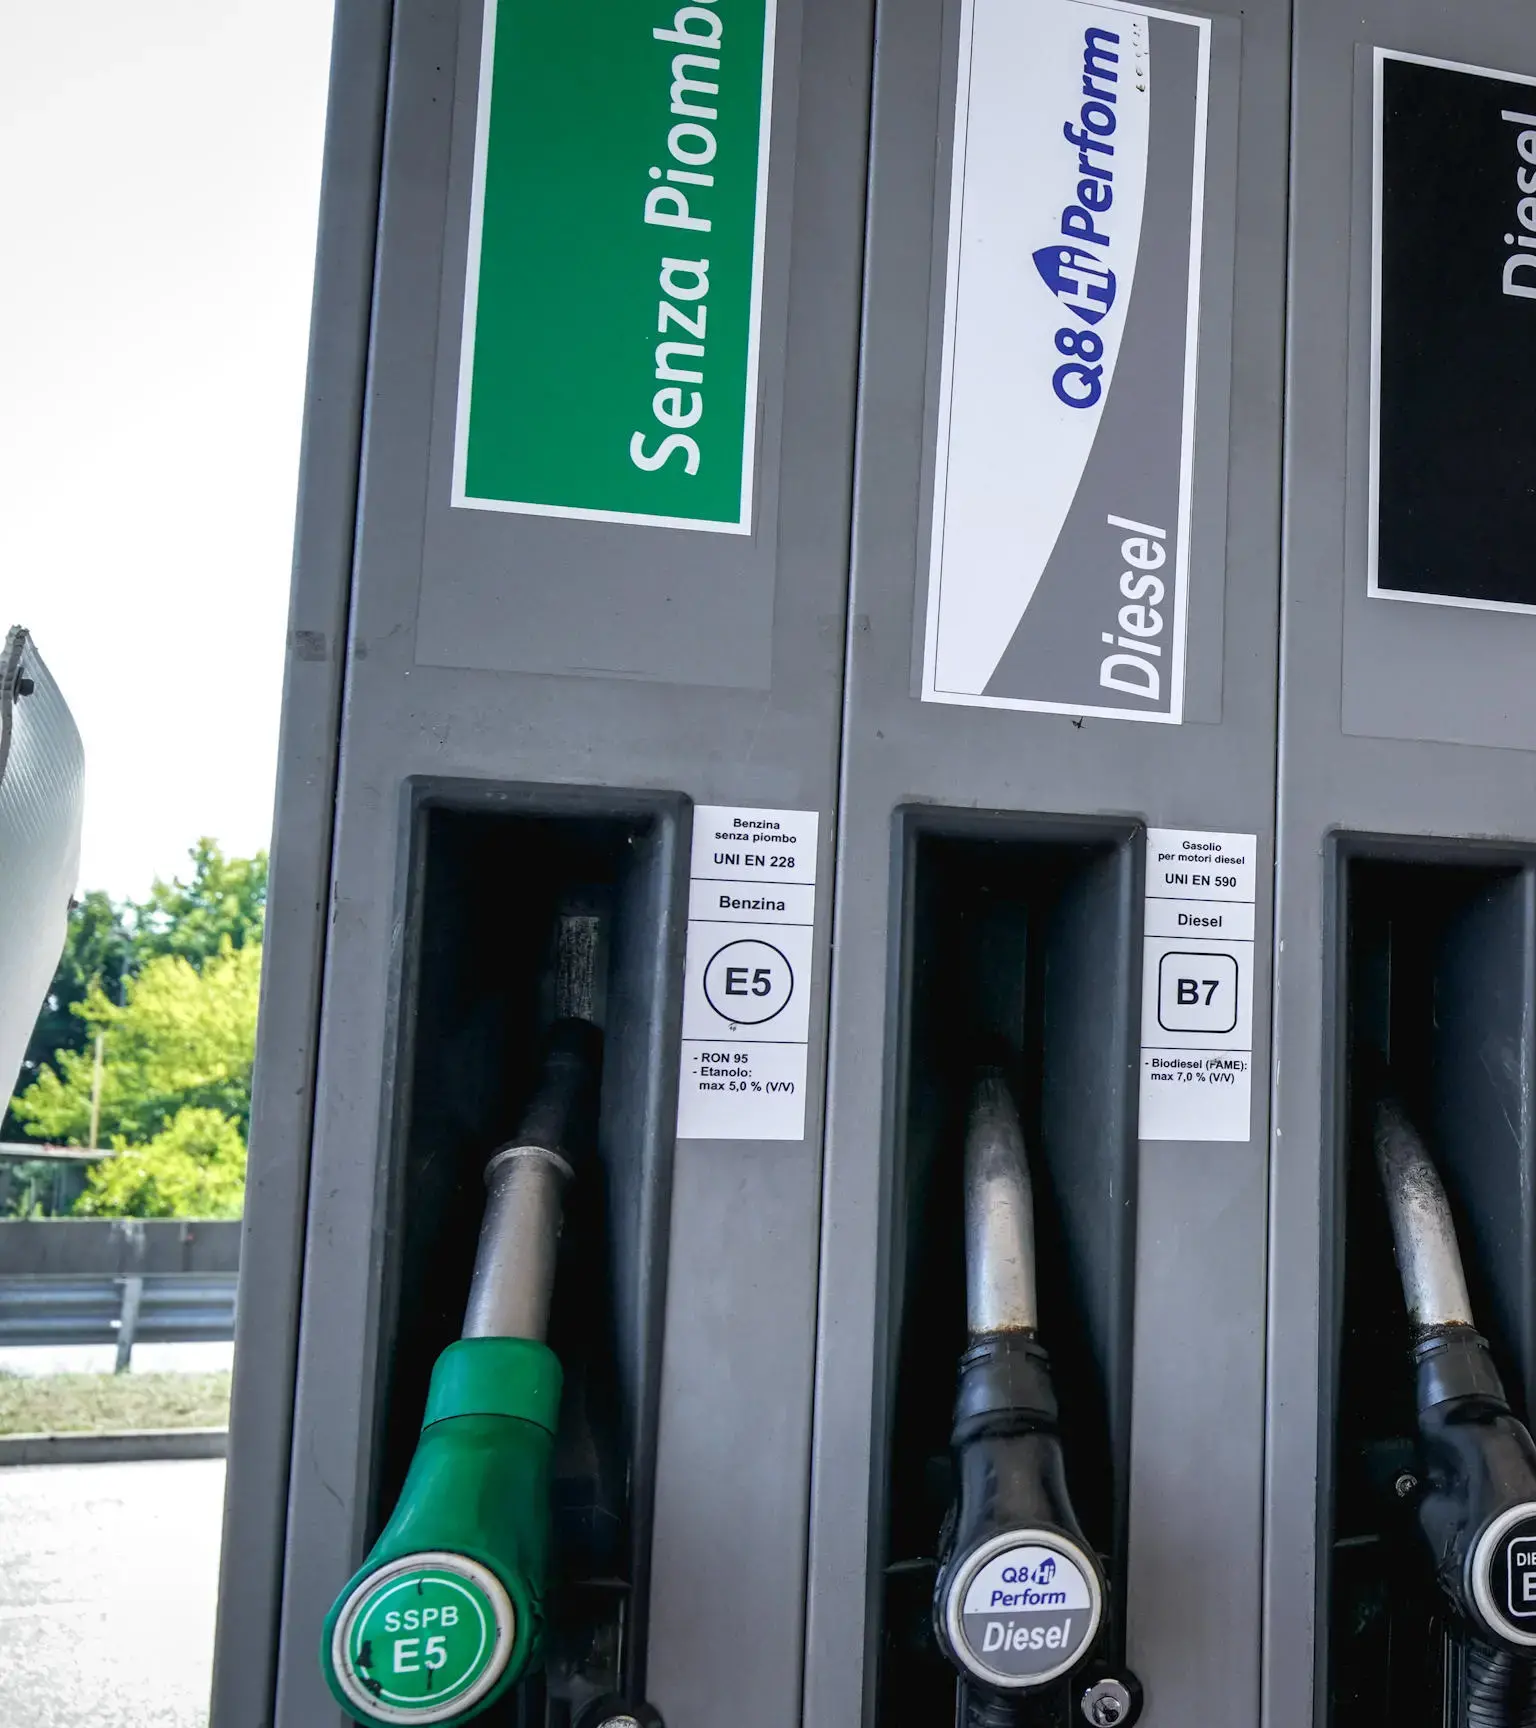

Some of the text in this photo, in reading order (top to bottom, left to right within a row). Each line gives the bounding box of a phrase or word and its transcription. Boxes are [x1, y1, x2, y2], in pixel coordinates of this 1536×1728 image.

[1061, 27, 1121, 247] Perform
[629, 0, 723, 476] Senza Piomb
[1052, 327, 1103, 409] Q8
[1099, 514, 1168, 700] Diesel
[733, 818, 780, 830] Benzina
[714, 831, 797, 844] senza piombo
[1182, 841, 1222, 852] Gasolio
[714, 853, 796, 868] UNI EN 228
[1158, 853, 1245, 865] per motori diesel
[1165, 873, 1237, 888] UNI EN 590
[719, 895, 786, 911] Benzina
[1178, 914, 1222, 928] Diesel
[724, 967, 772, 997] E5
[1177, 978, 1220, 1007] B7
[701, 1053, 731, 1064] RON
[733, 1054, 748, 1064] 95
[1152, 1058, 1203, 1070] Biodiesel
[1205, 1059, 1248, 1072] (FAME):
[701, 1066, 752, 1078] Etanolo:
[1151, 1072, 1235, 1085] max 7,0 % (V/V)
[699, 1081, 795, 1094] max 5,0 % (V/V)
[1002, 1567, 1029, 1584] Q8
[990, 1588, 1066, 1607] Perform
[384, 1605, 460, 1632] SSPB
[982, 1617, 1071, 1652] Diesel
[393, 1636, 448, 1673] E5
